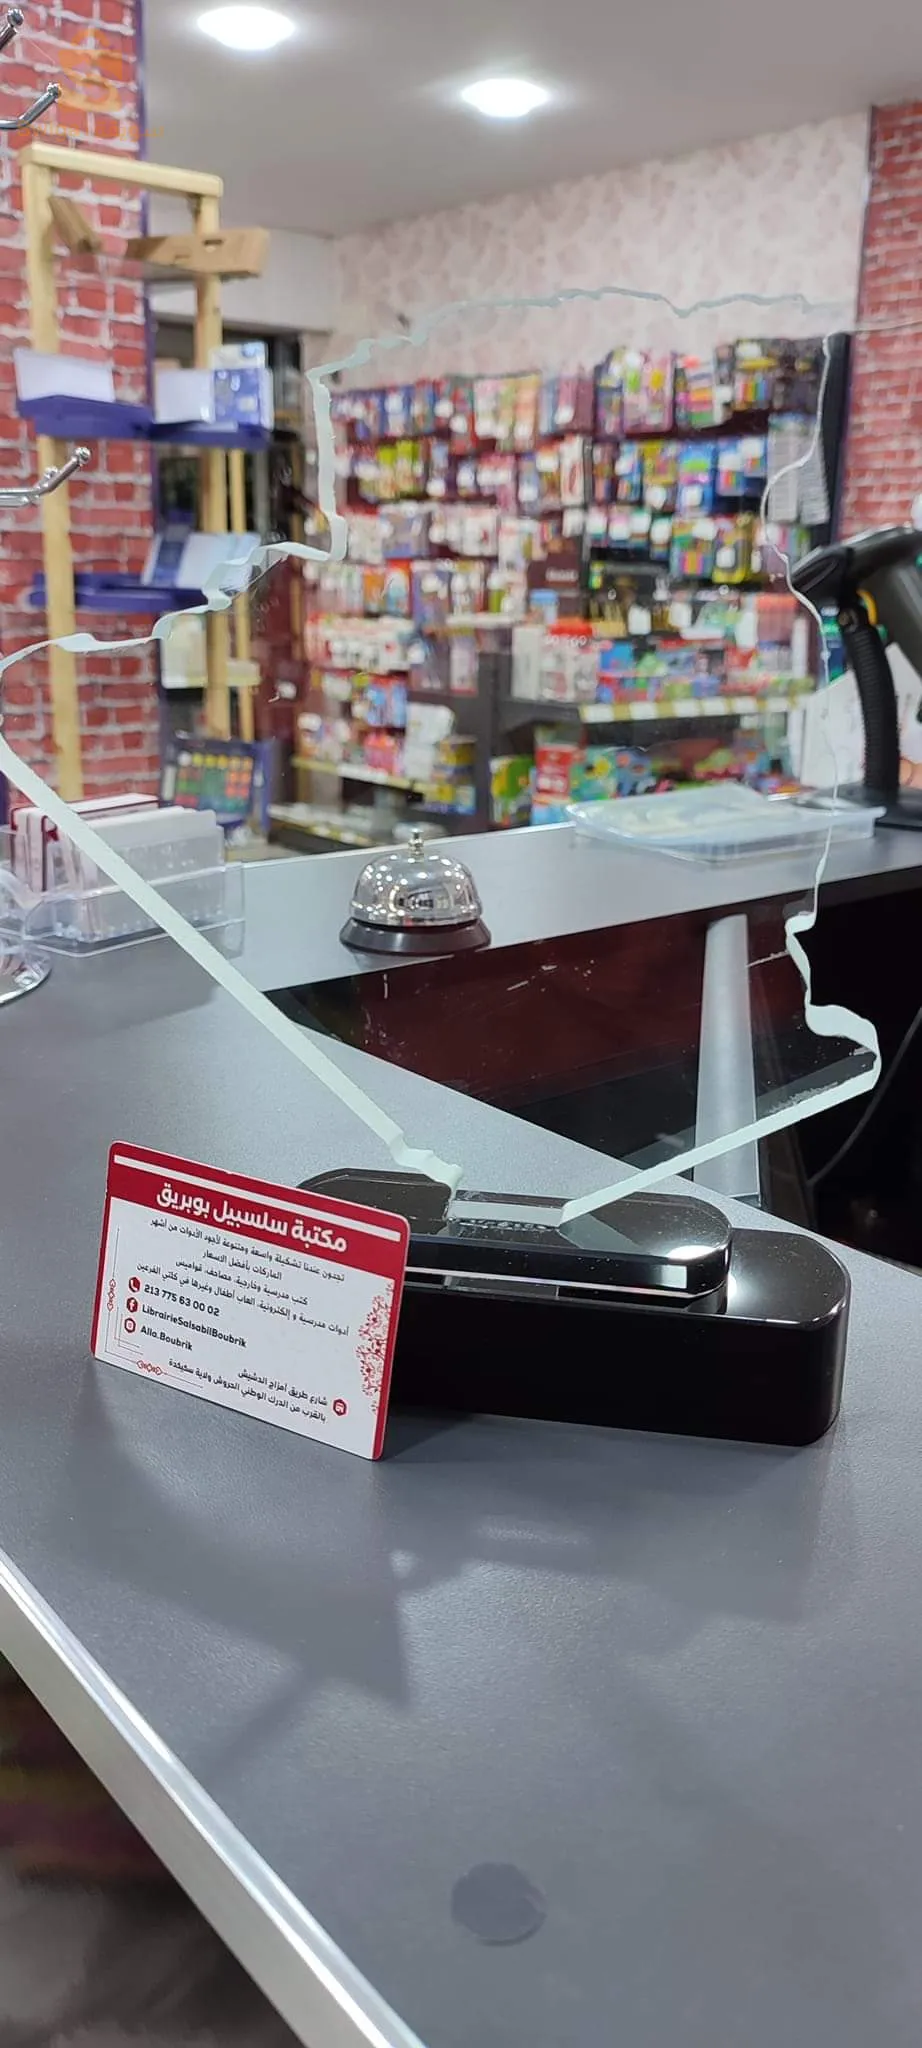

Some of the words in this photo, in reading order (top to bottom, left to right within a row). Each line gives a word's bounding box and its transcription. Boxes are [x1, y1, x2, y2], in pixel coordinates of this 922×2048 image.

[157, 1183, 210, 1218] بوبريق
[213, 1201, 288, 1235] سلسبيل
[168, 1224, 178, 1232] من
[291, 1220, 347, 1251] مكتبة
[250, 1246, 273, 1262] واسعة
[274, 1254, 301, 1269] تشكيلة
[179, 1278, 189, 1287] في
[263, 1284, 290, 1300] مدرسية
[144, 1284, 160, 1296] 213
[161, 1289, 177, 1302] 775
[179, 1295, 191, 1307] 63
[192, 1300, 206, 1312] 00
[207, 1305, 220, 1317] 02
[291, 1296, 308, 1306] كتب
[142, 1304, 246, 1348] LibrairieSalsabilBoubrik
[299, 1313, 326, 1329] مدرسية
[195, 1367, 212, 1383] ولاية
[240, 1388, 267, 1401] الوطني
[288, 1386, 308, 1399] طريق
[289, 1404, 300, 1413] من
[309, 1396, 327, 1406] شارع
[302, 1410, 326, 1424] بالقرب
